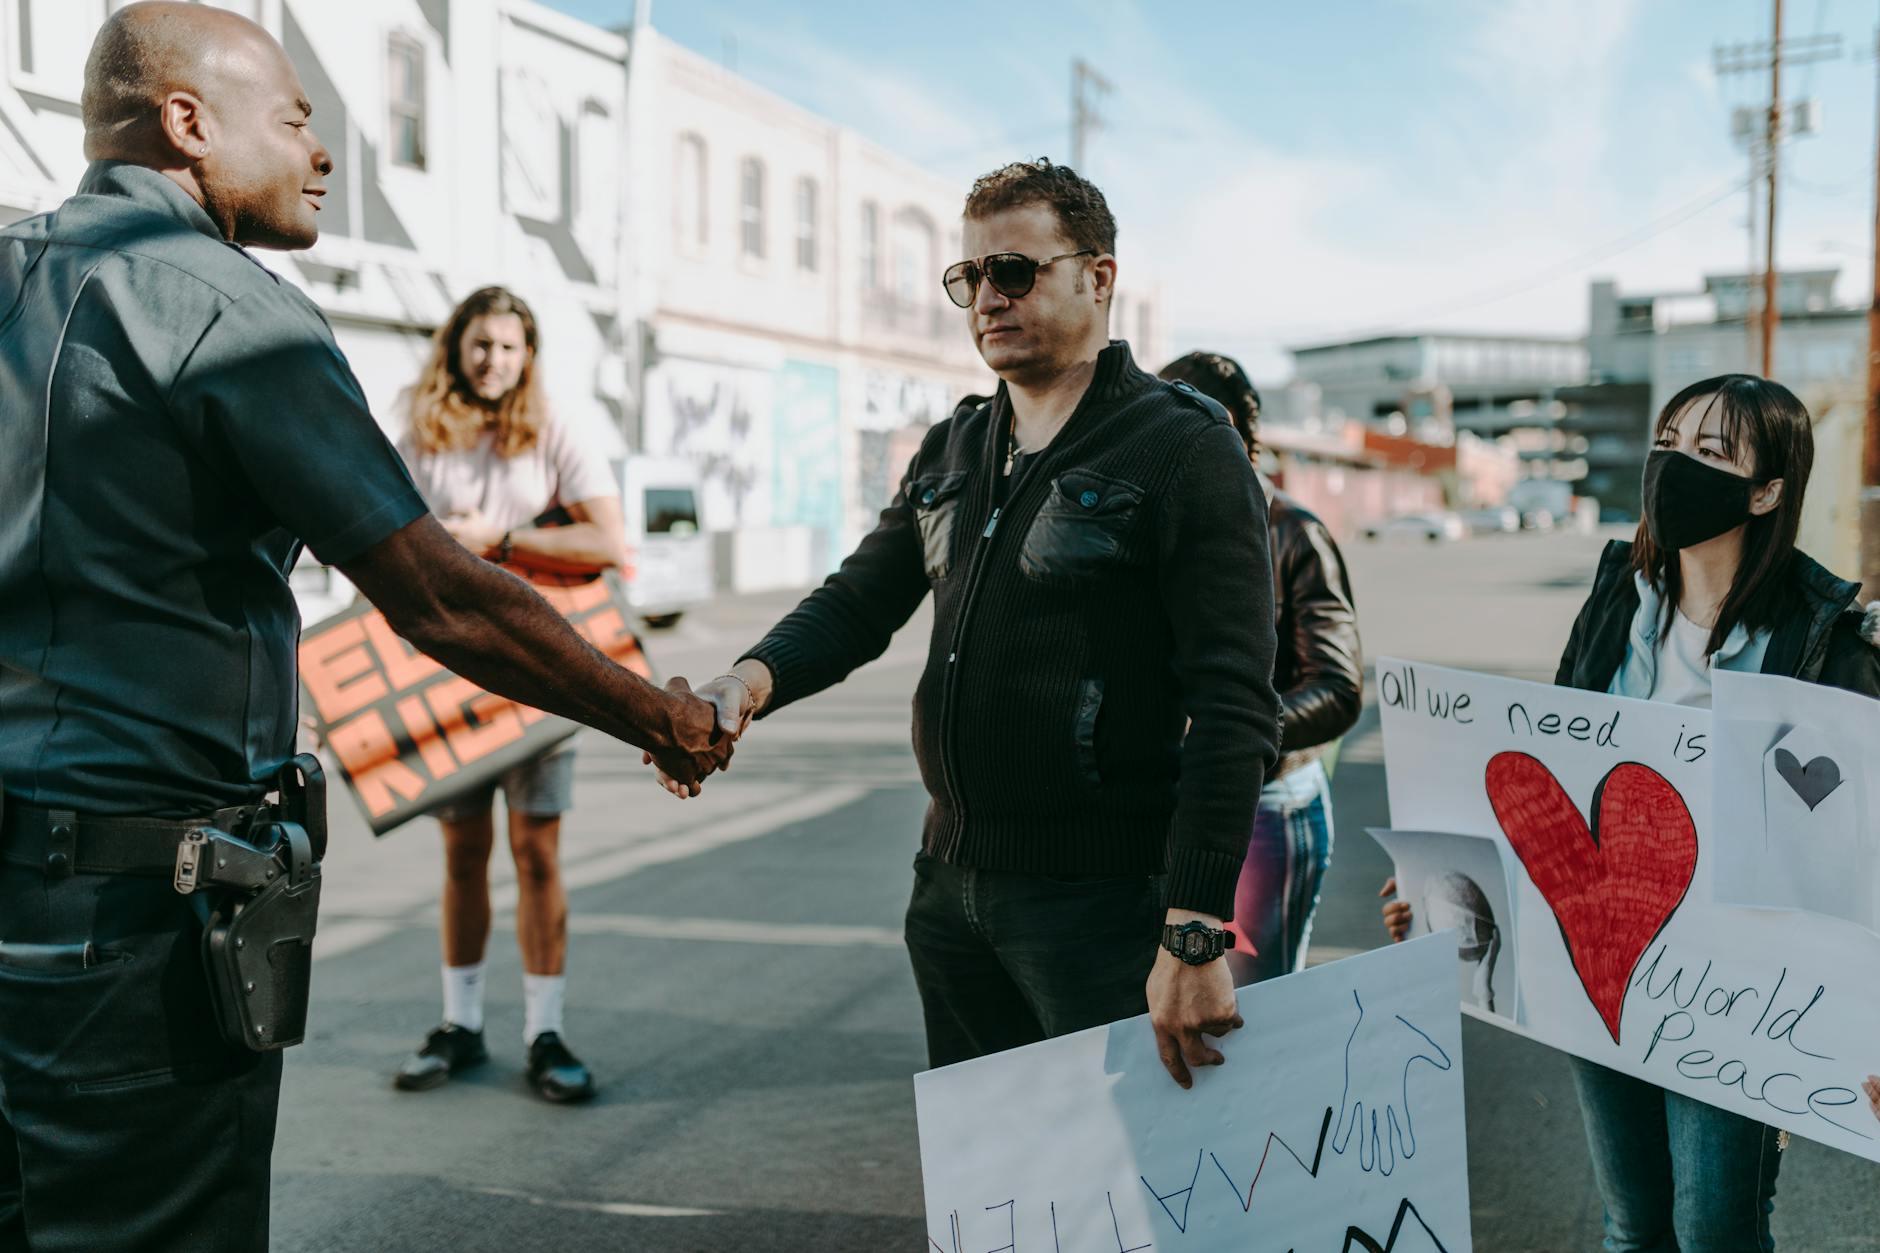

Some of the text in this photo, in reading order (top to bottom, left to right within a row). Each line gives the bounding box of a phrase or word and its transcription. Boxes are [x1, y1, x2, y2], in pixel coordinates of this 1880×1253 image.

[1427, 687, 1474, 724] we
[1507, 702, 1621, 748] need
[1673, 724, 1707, 763] is
[1635, 944, 1836, 1060] World
